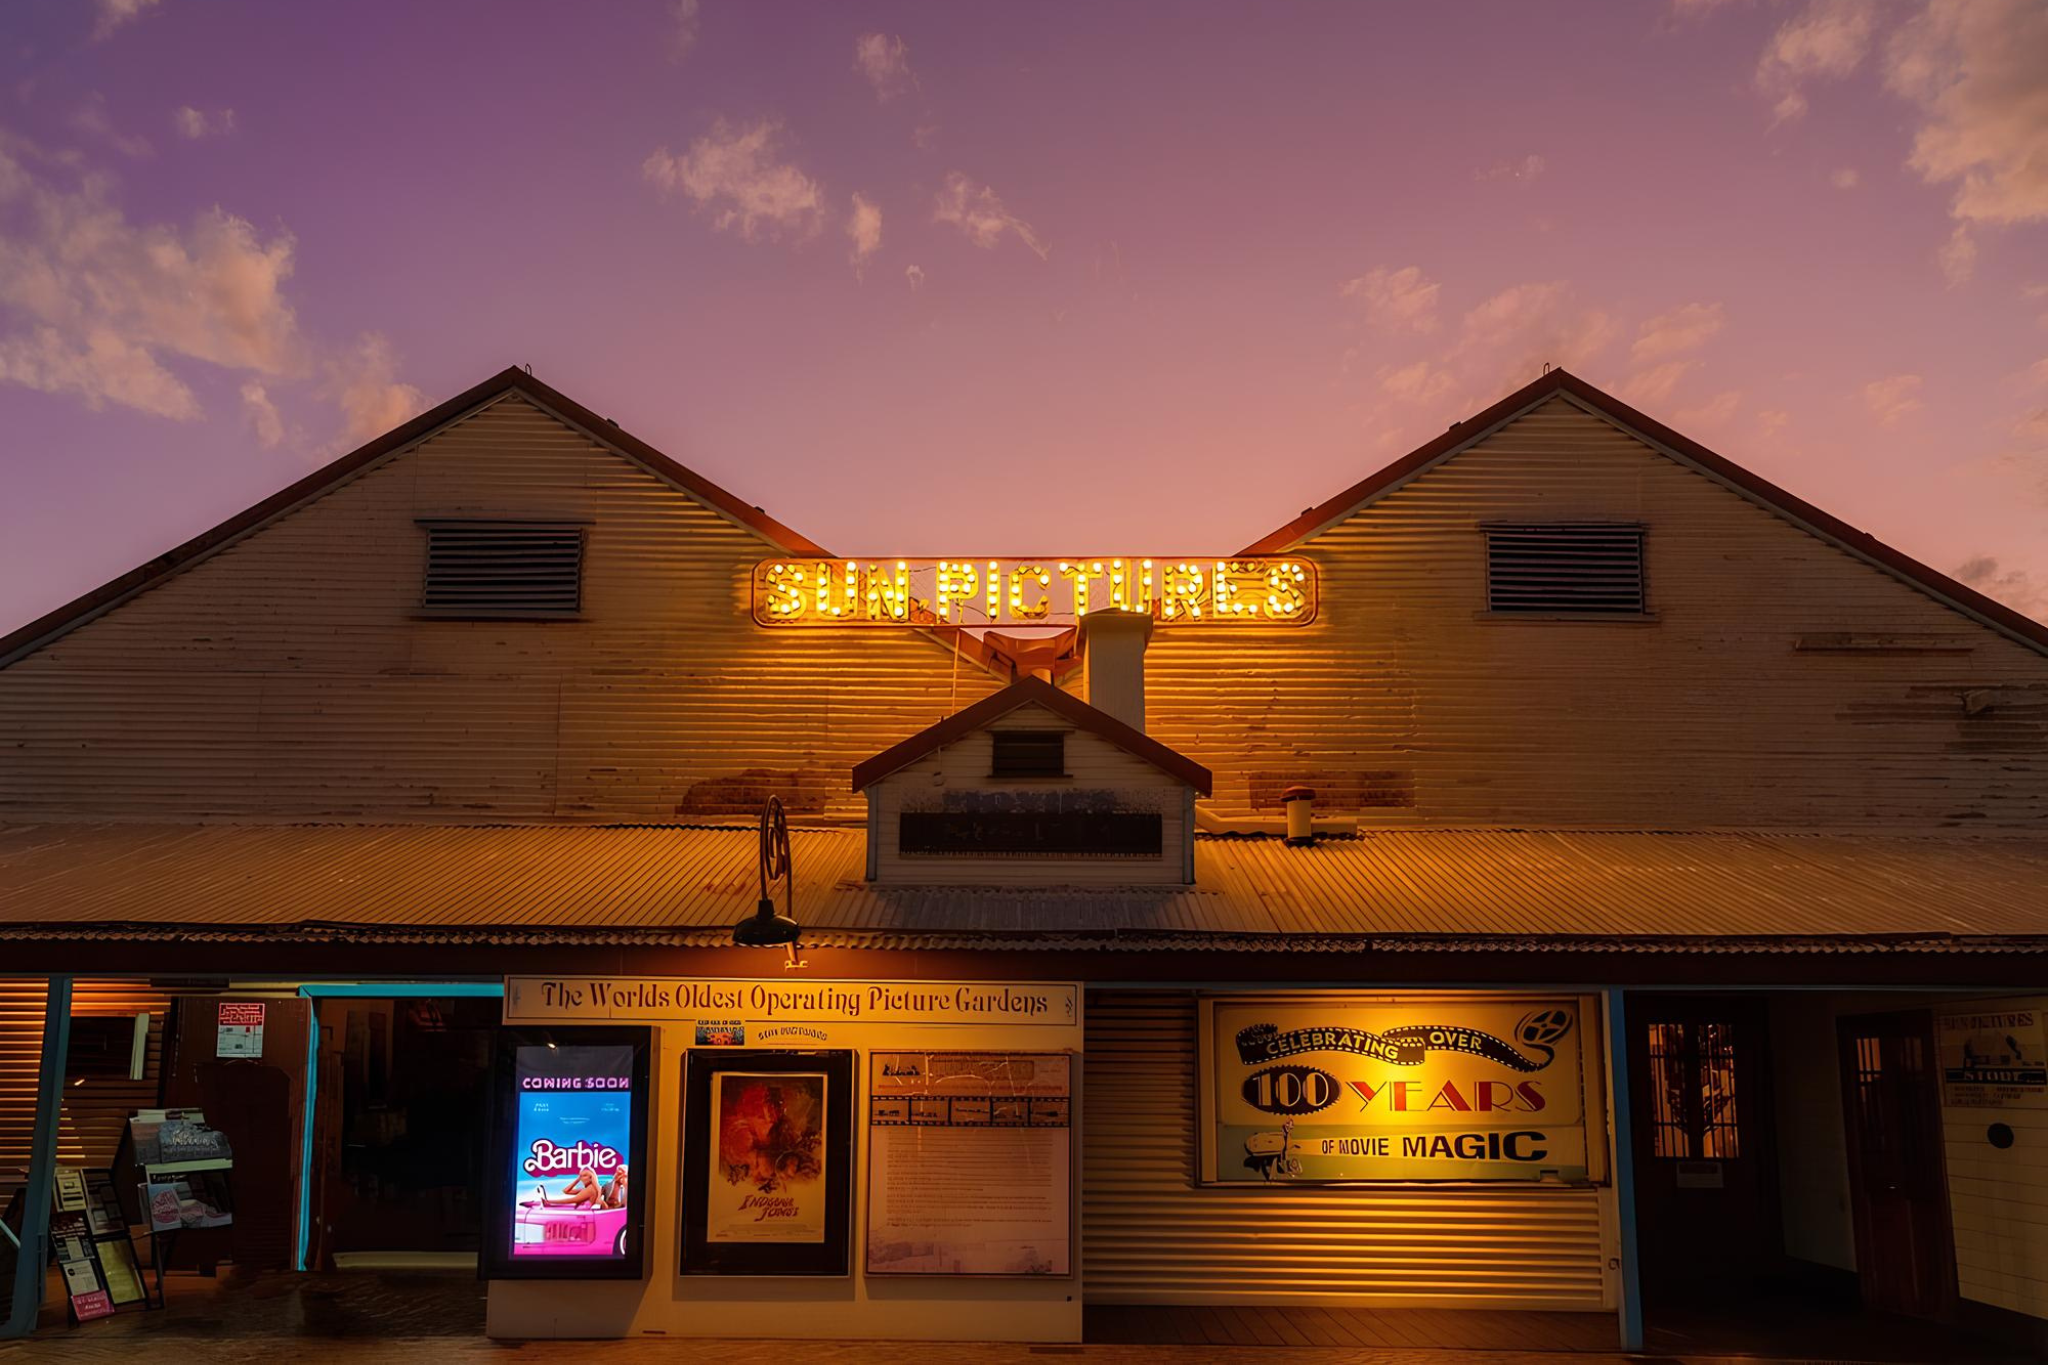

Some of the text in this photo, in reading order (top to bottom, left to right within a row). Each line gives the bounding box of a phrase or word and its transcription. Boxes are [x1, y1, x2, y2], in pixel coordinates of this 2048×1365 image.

[767, 560, 1304, 620] SUN PICTURES
[541, 982, 1048, 1016] The Worlds Oldest Operating Picture Gardens
[1266, 1030, 1482, 1060] CELEBRATING OVER
[522, 1077, 630, 1089] COMING SOON
[1252, 1072, 1547, 1112] 100 YEARS
[524, 1139, 617, 1172] Barbie
[1321, 1131, 1548, 1162] OF MOVIE MAGIC
